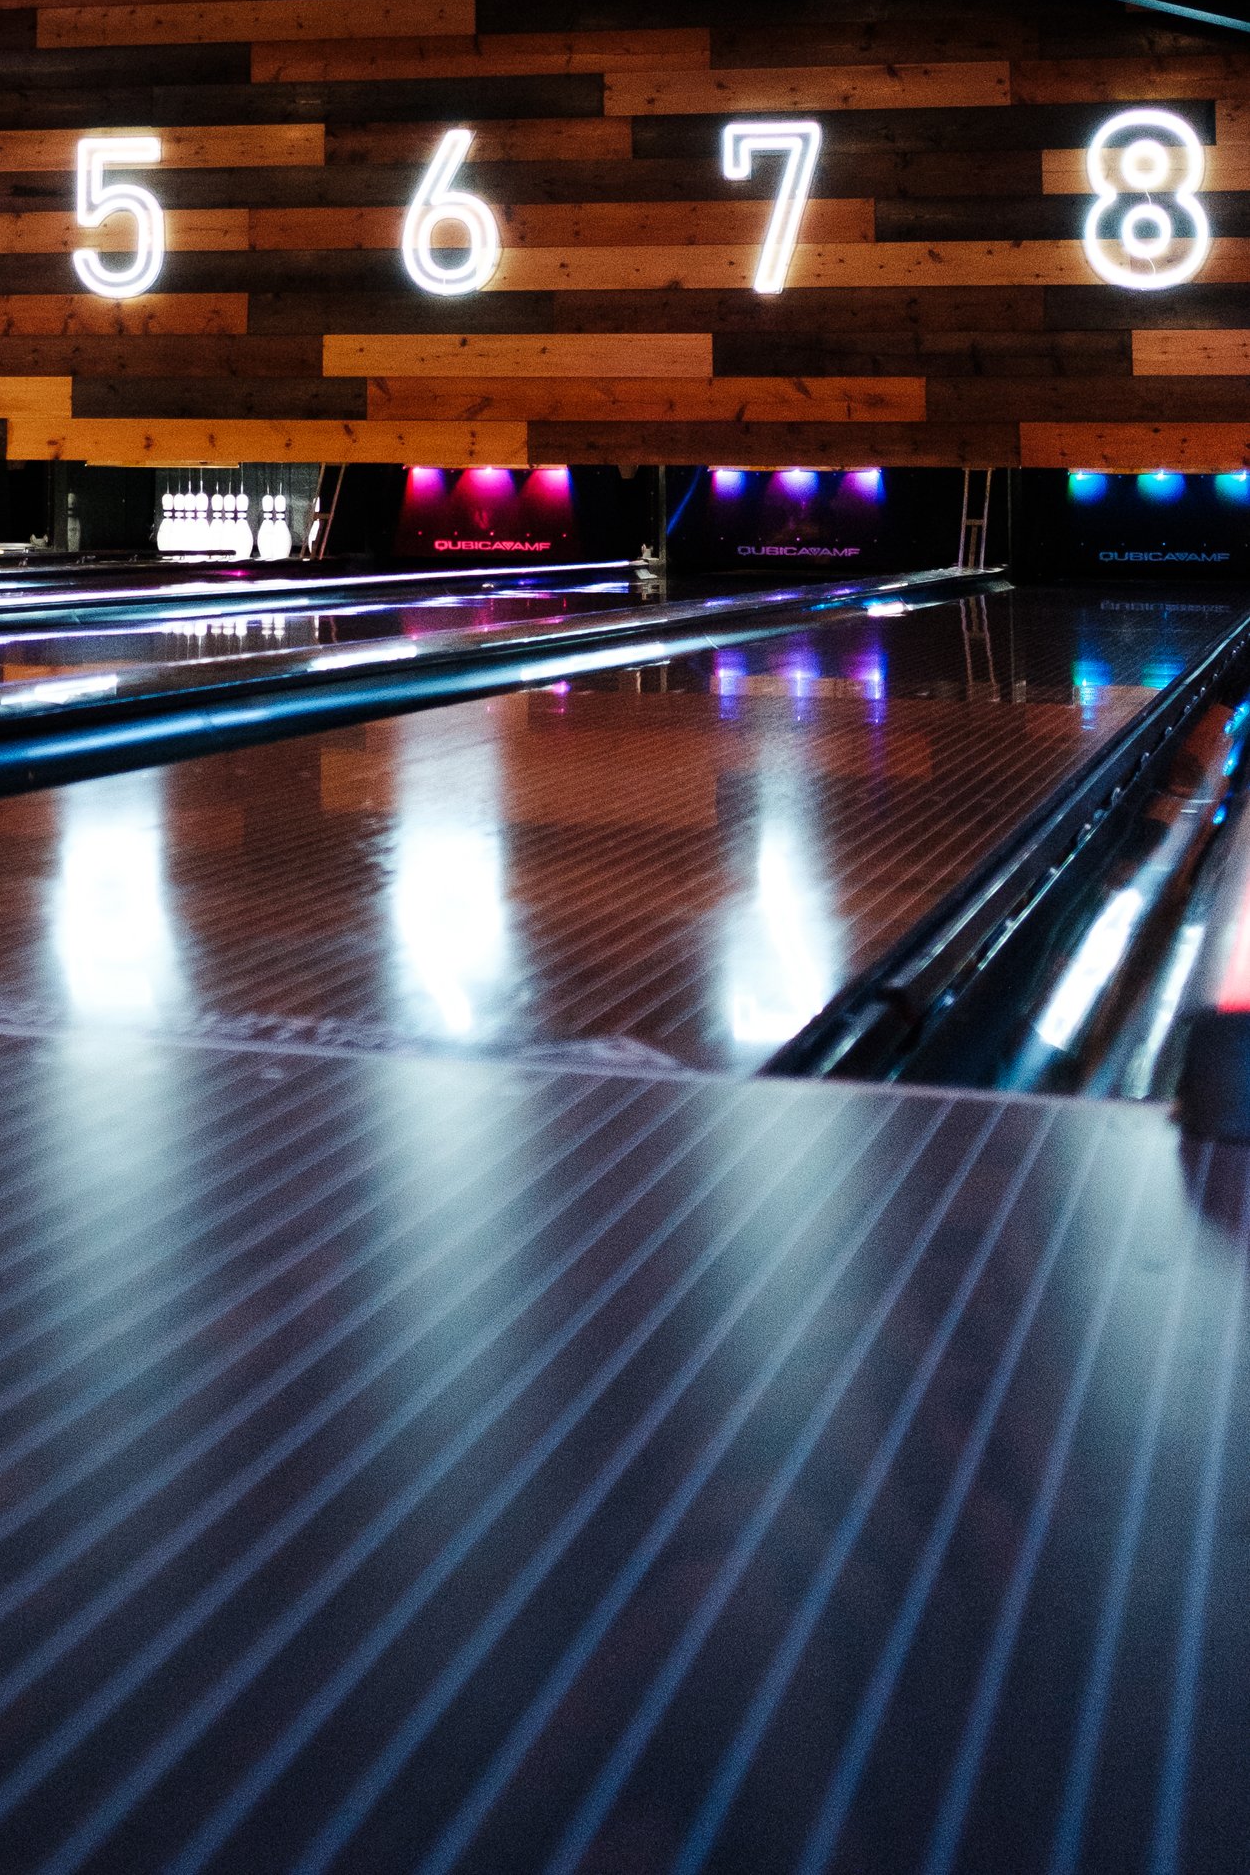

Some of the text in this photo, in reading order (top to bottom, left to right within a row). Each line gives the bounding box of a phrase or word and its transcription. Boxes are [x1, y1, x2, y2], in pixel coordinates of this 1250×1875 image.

[71, 135, 165, 299] 5
[400, 128, 501, 297] 6
[722, 120, 822, 294] 7
[1081, 108, 1212, 291] 8
